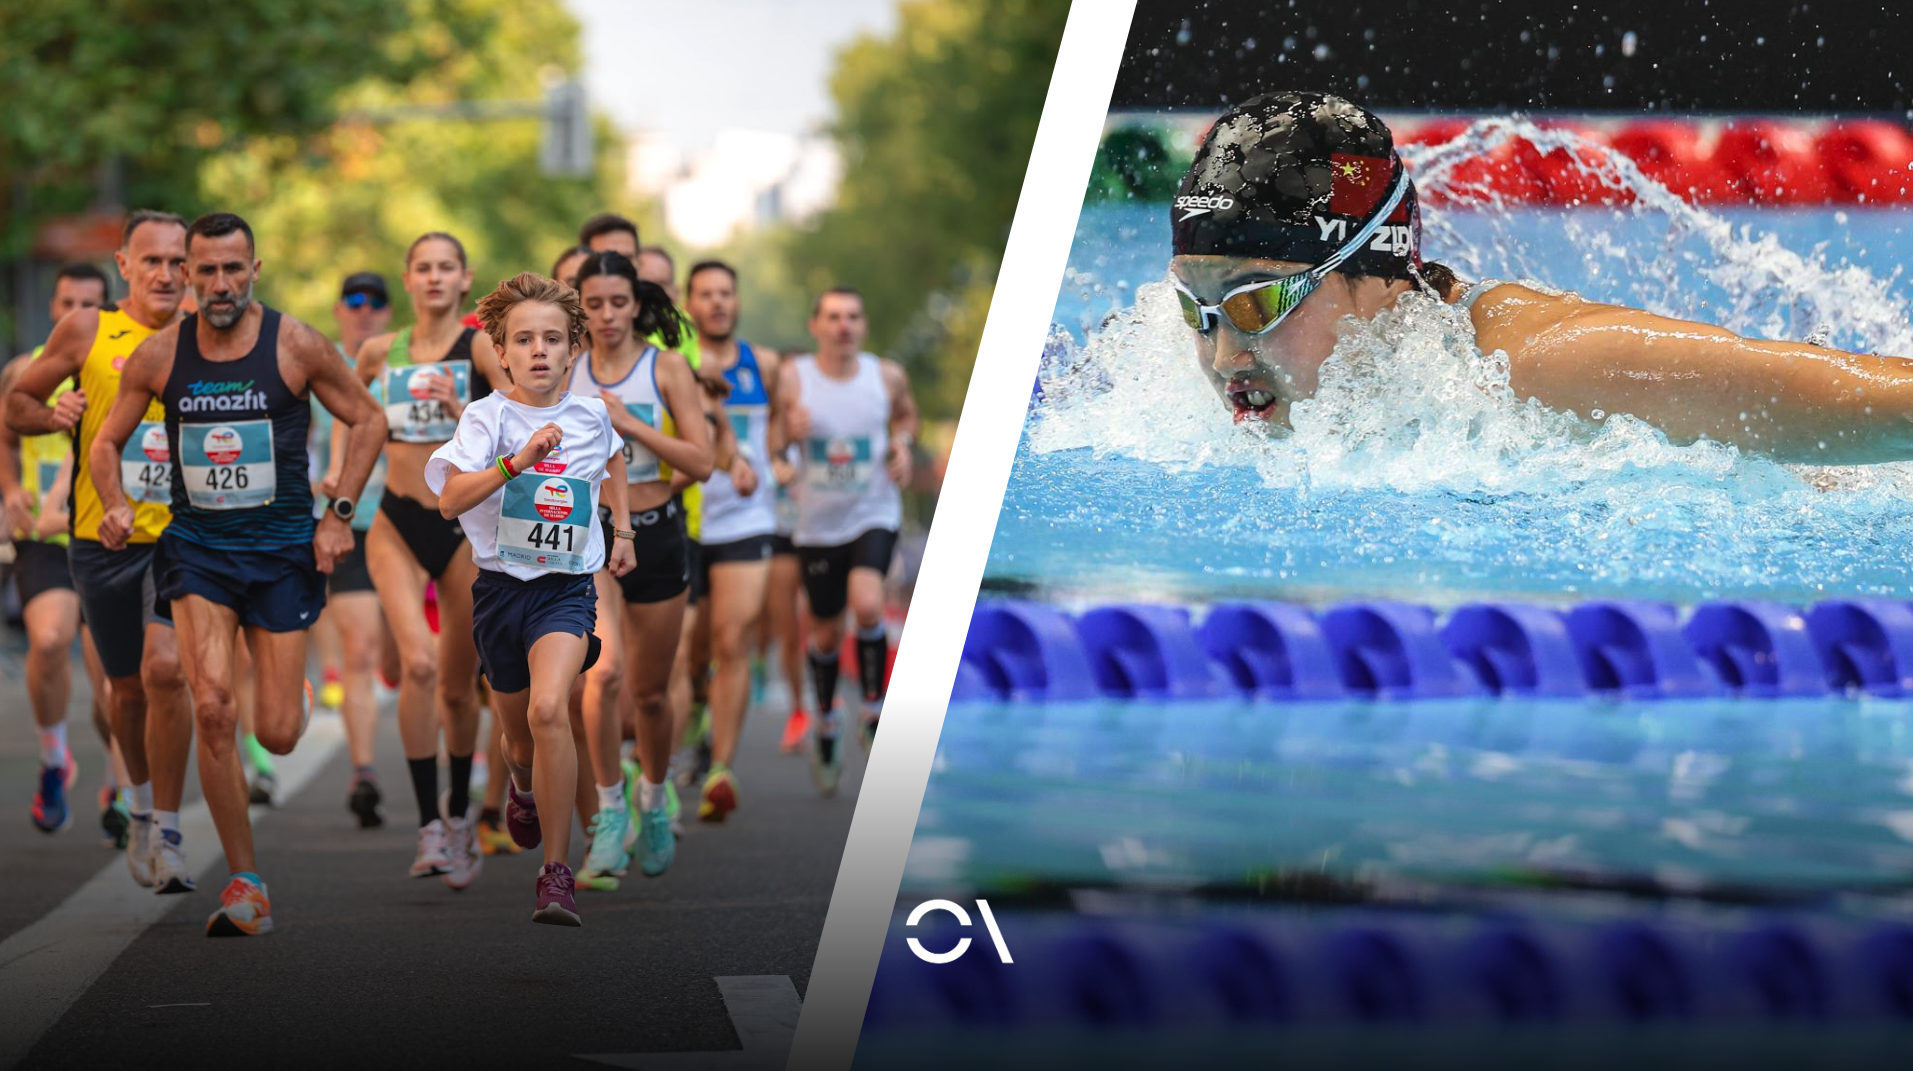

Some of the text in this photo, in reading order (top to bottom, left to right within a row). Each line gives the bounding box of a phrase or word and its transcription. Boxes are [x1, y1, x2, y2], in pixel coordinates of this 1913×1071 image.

[1174, 194, 1233, 209] speedo
[187, 380, 254, 395] team
[178, 389, 268, 412] amazfit
[206, 466, 249, 491] 426
[527, 522, 573, 552] 441
[507, 551, 532, 561] MADRID
